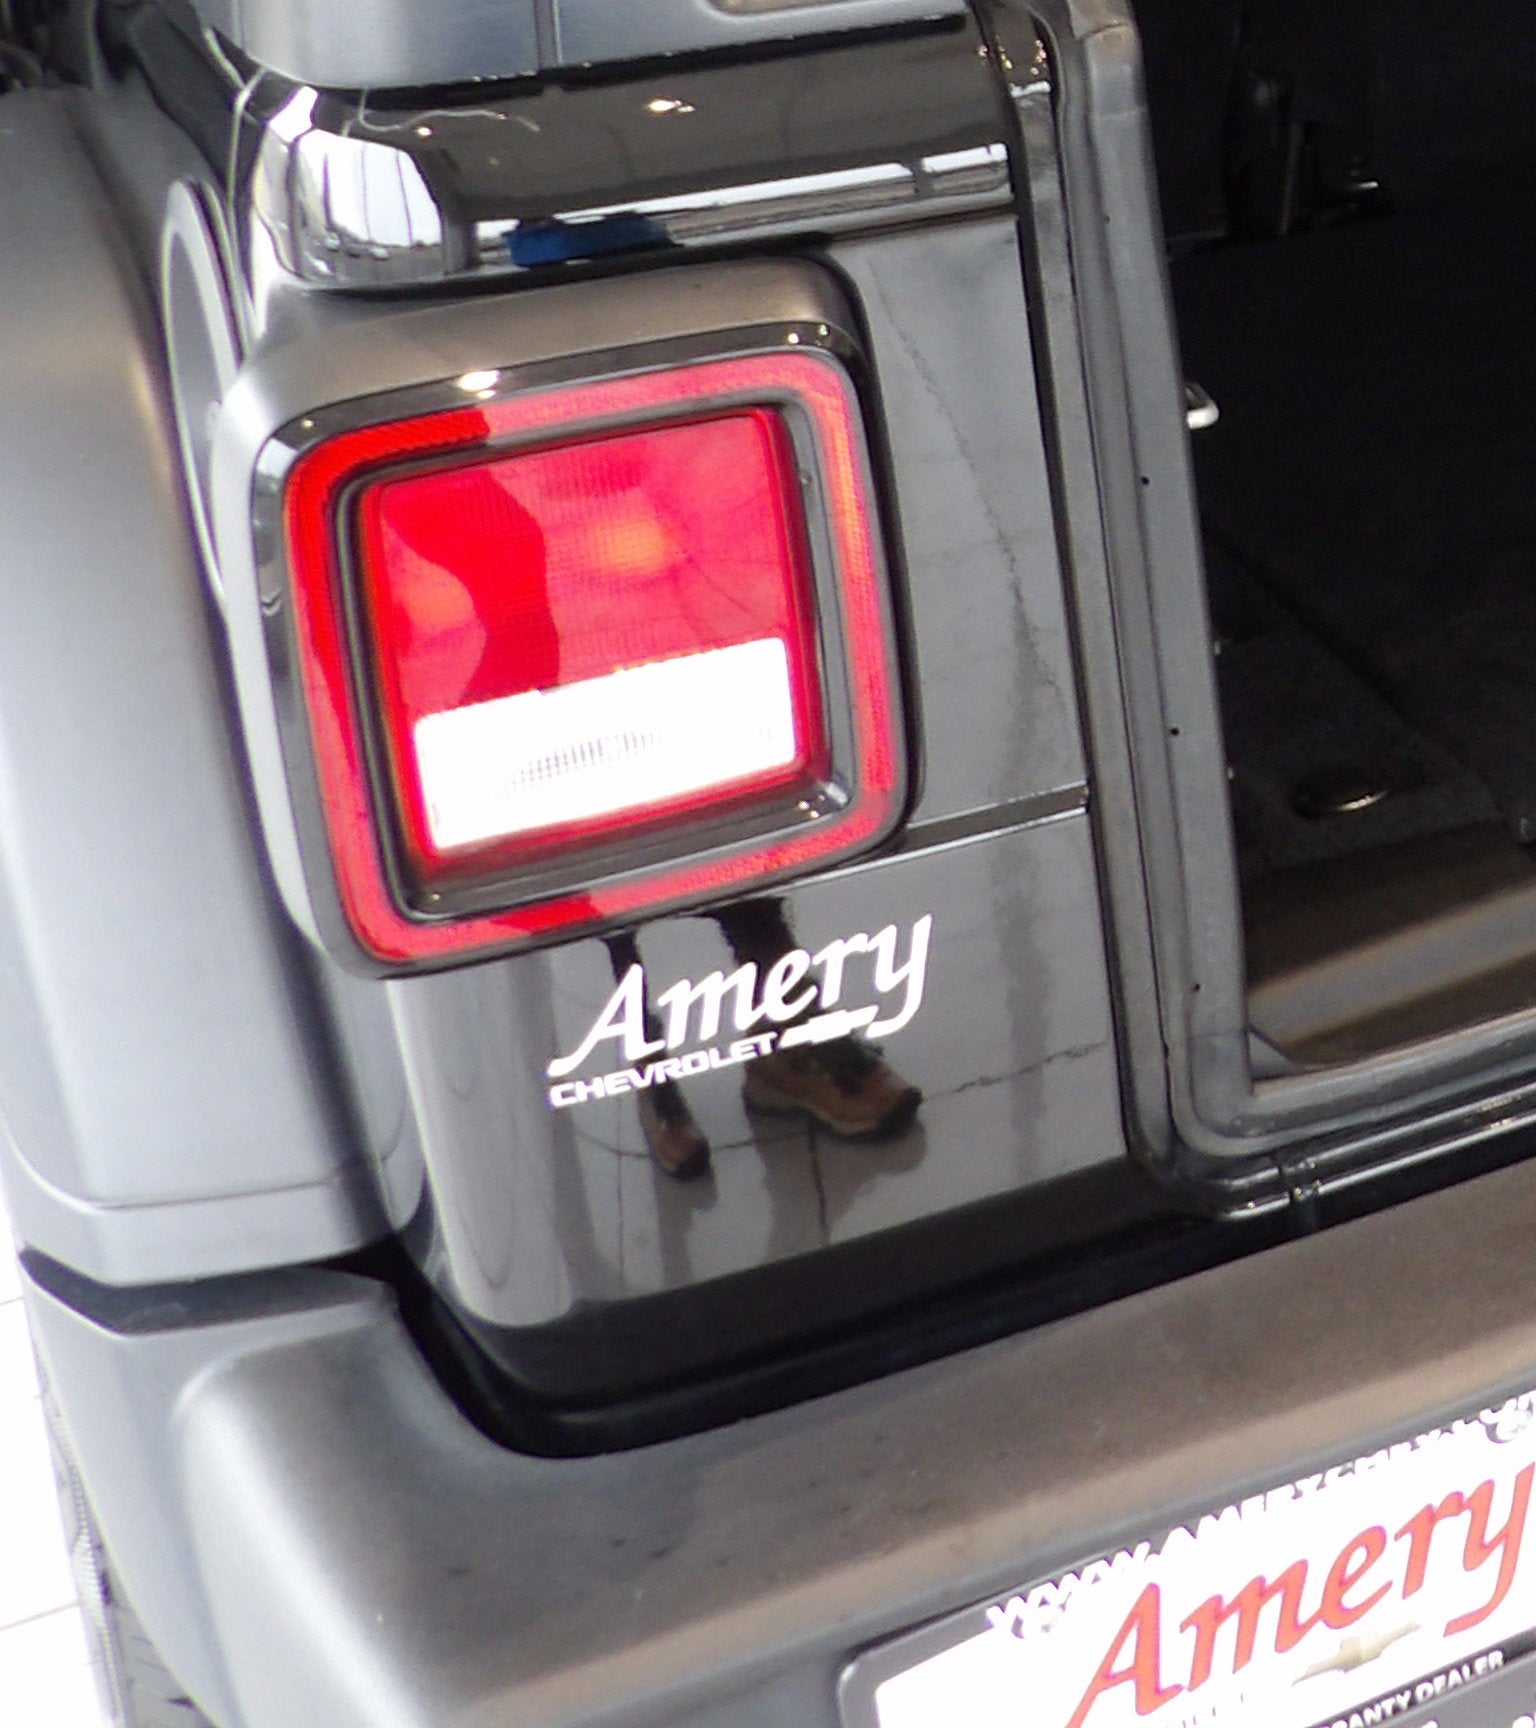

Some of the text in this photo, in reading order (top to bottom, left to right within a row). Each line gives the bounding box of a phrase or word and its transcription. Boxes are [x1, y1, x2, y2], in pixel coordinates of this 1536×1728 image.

[547, 912, 933, 1077] Amery
[549, 1030, 779, 1109] CHEVROLET
[1064, 1460, 1536, 1728] Amery
[1414, 1649, 1503, 1704] DEALER
